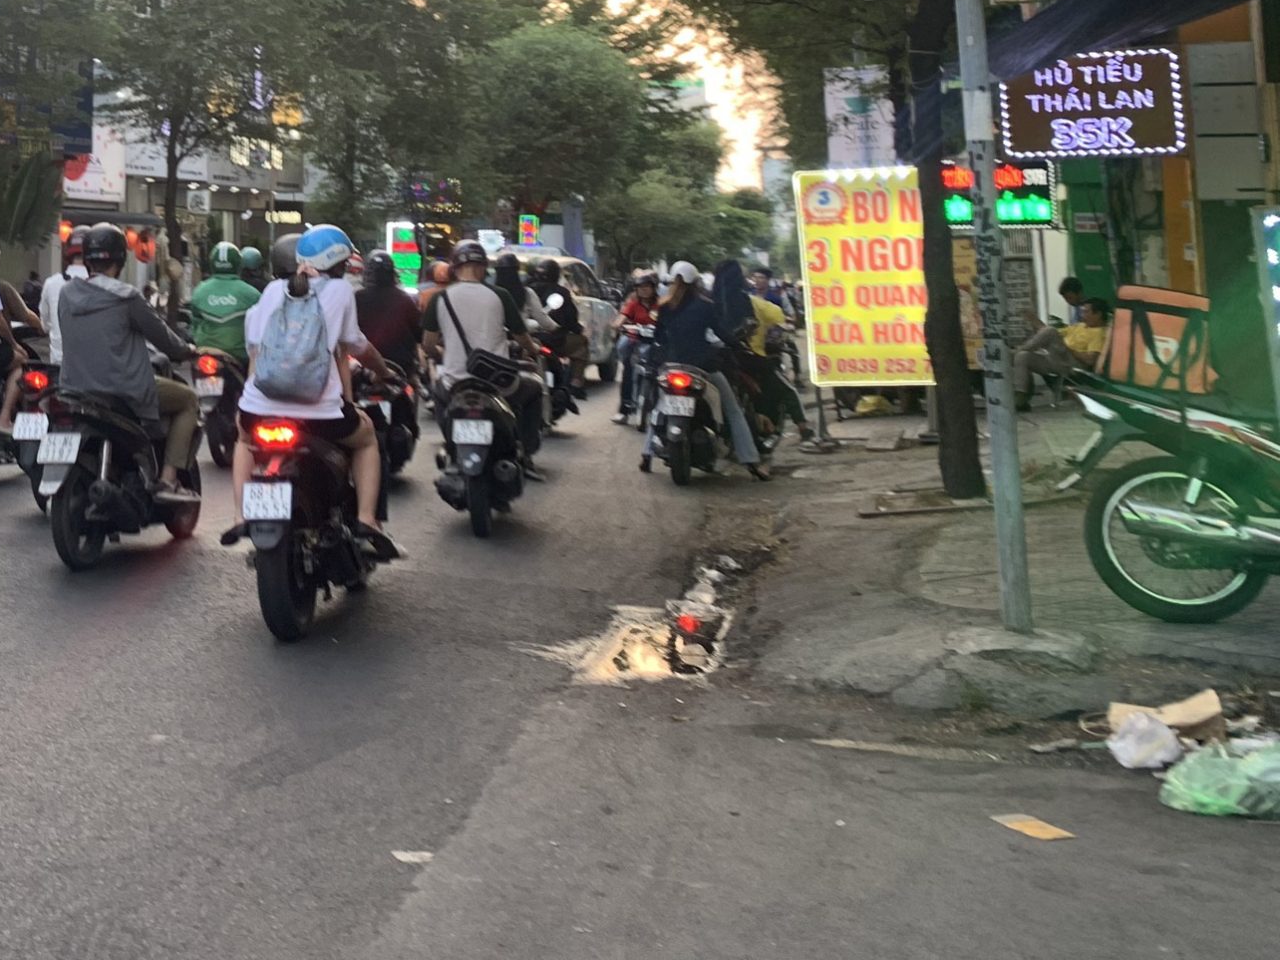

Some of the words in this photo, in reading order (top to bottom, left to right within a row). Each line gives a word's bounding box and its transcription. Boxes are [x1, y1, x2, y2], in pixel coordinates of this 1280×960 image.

[1034, 59, 1073, 87] HỦ
[1025, 87, 1092, 113] THÁI
[1098, 88, 1155, 110] LAN
[1050, 116, 1136, 150] 35K
[853, 182, 889, 224] BÒ
[807, 239, 828, 272] 3
[208, 293, 237, 306] Grab
